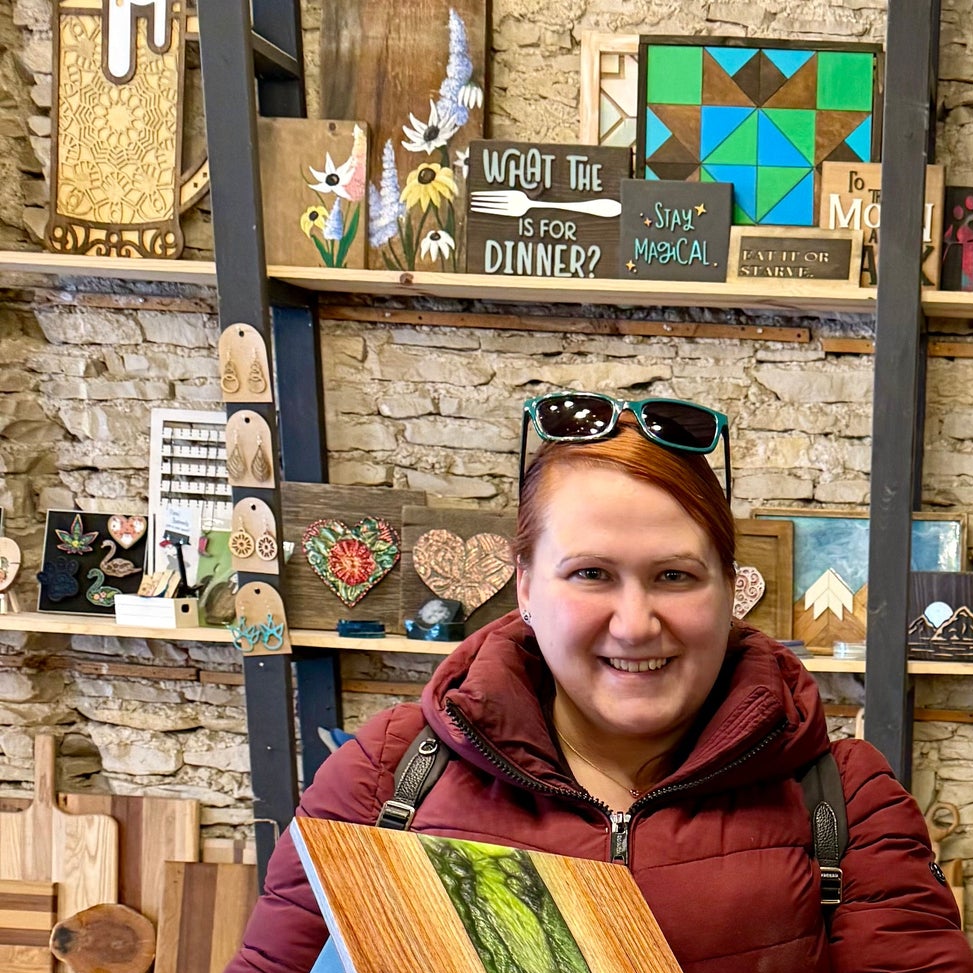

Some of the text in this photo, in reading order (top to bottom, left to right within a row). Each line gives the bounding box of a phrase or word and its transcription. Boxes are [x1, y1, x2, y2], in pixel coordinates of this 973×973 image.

[483, 148, 603, 193] WHAT THE
[518, 218, 577, 242] IS FOR
[654, 202, 695, 232] STAY
[484, 239, 601, 279] DINNER?
[742, 249, 830, 262] EAT IT OR
